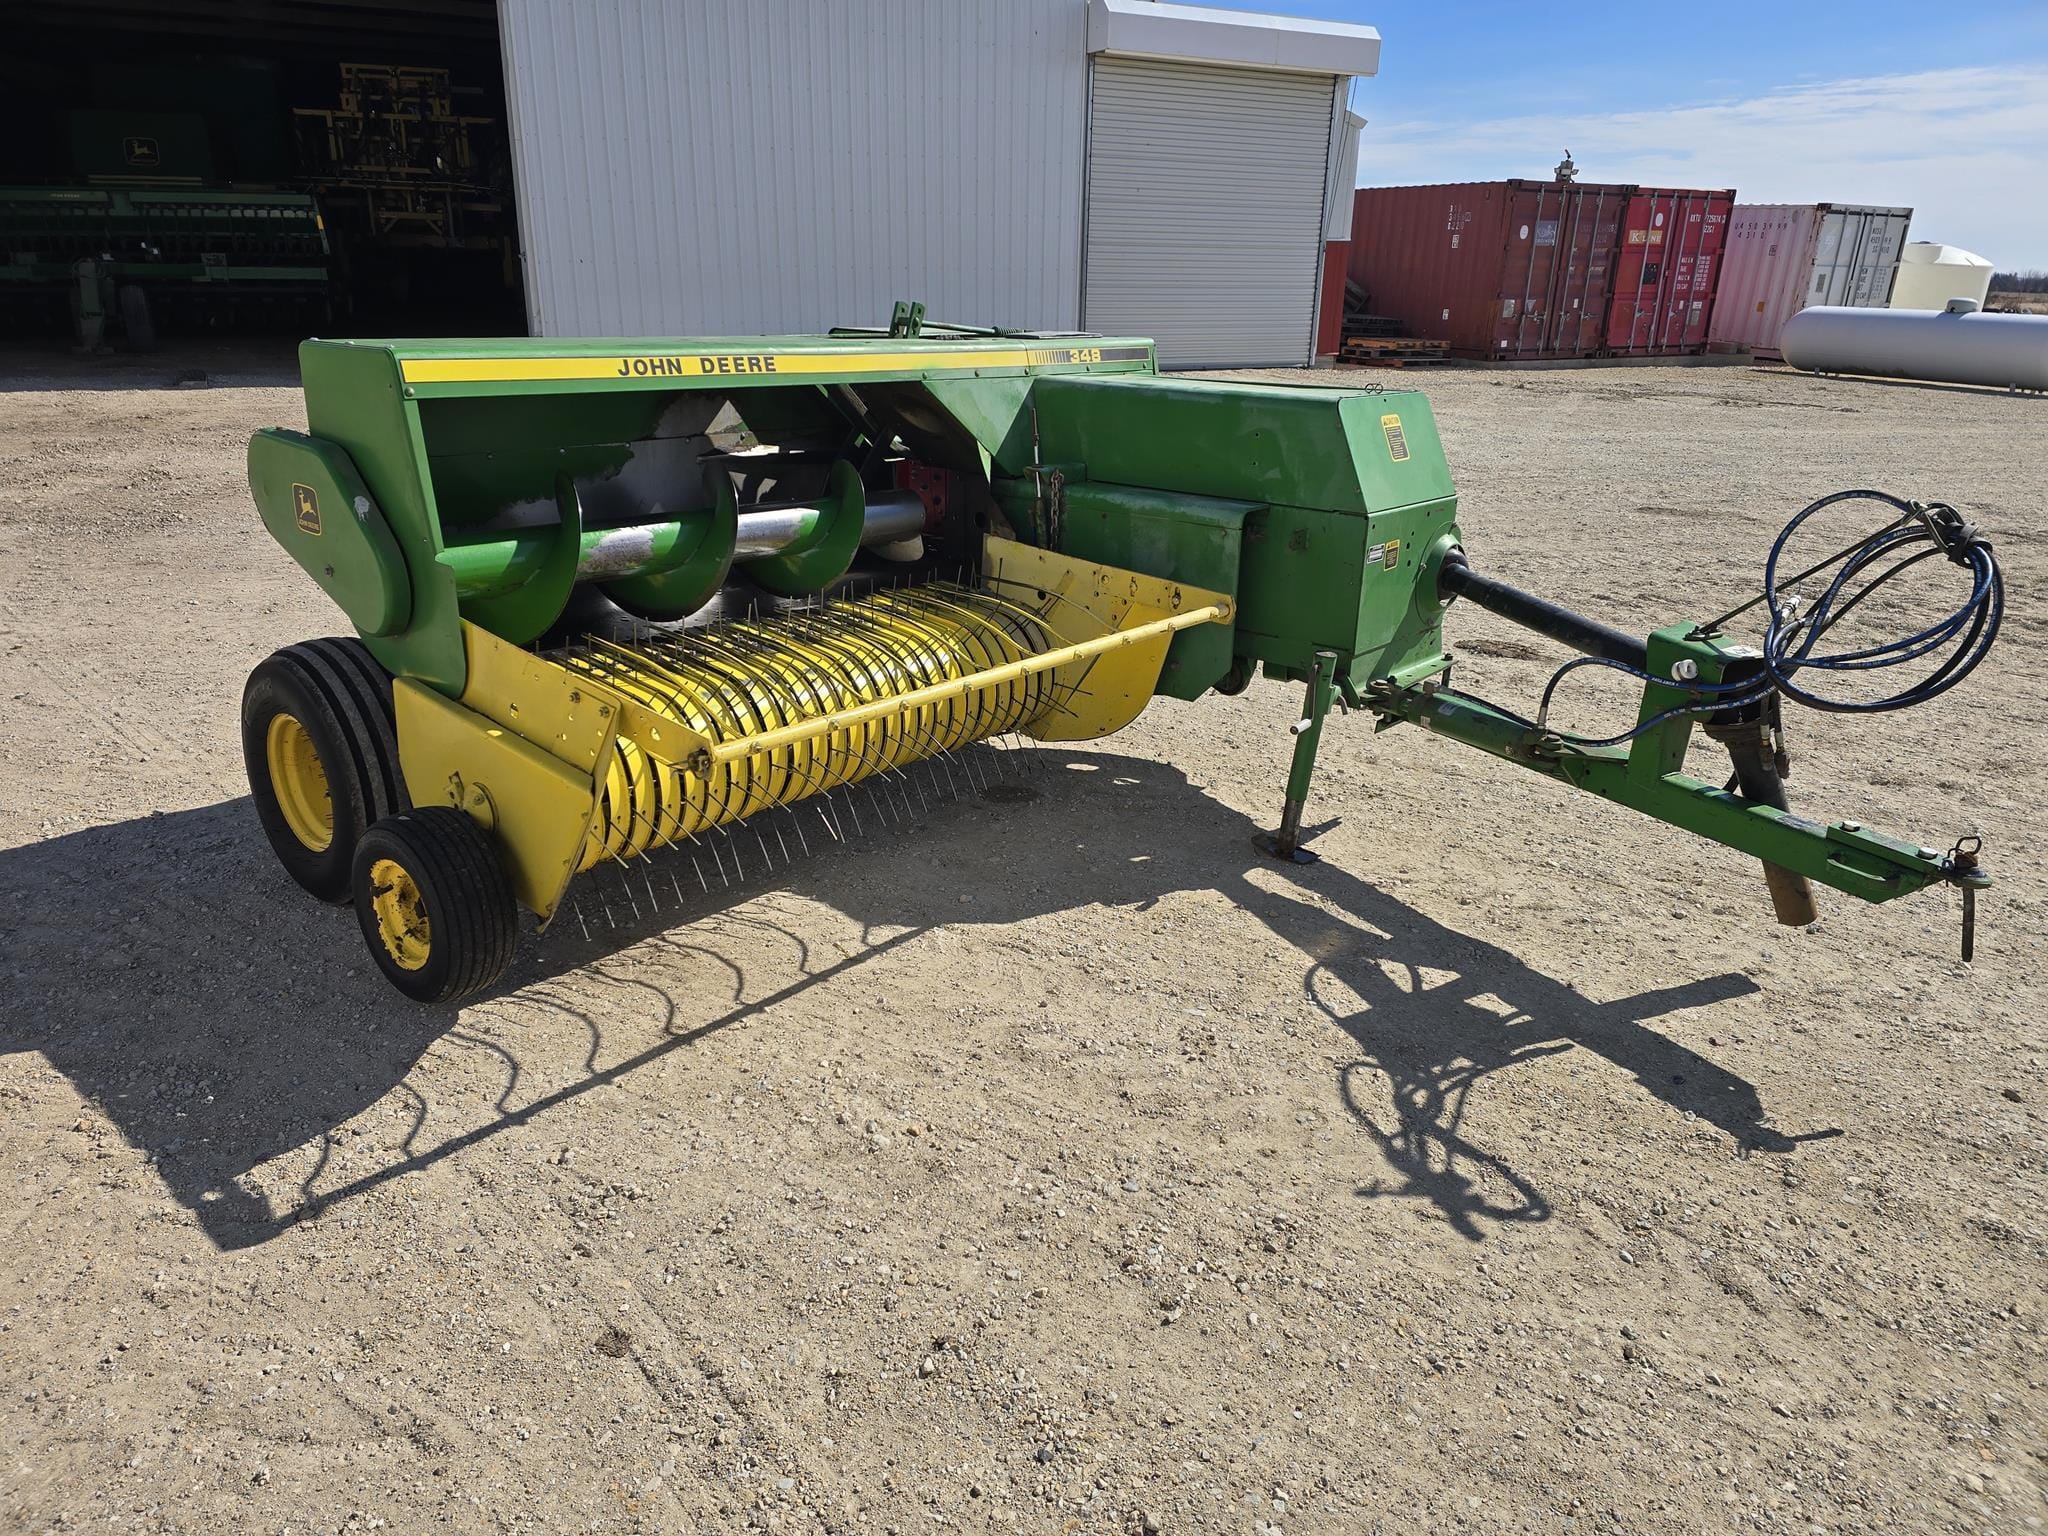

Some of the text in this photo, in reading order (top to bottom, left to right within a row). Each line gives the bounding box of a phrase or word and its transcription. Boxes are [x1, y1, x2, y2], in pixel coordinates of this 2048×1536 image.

[1631, 232, 1640, 241] K
[1069, 348, 1101, 364] 348
[617, 356, 777, 376] JOHN DEERE
